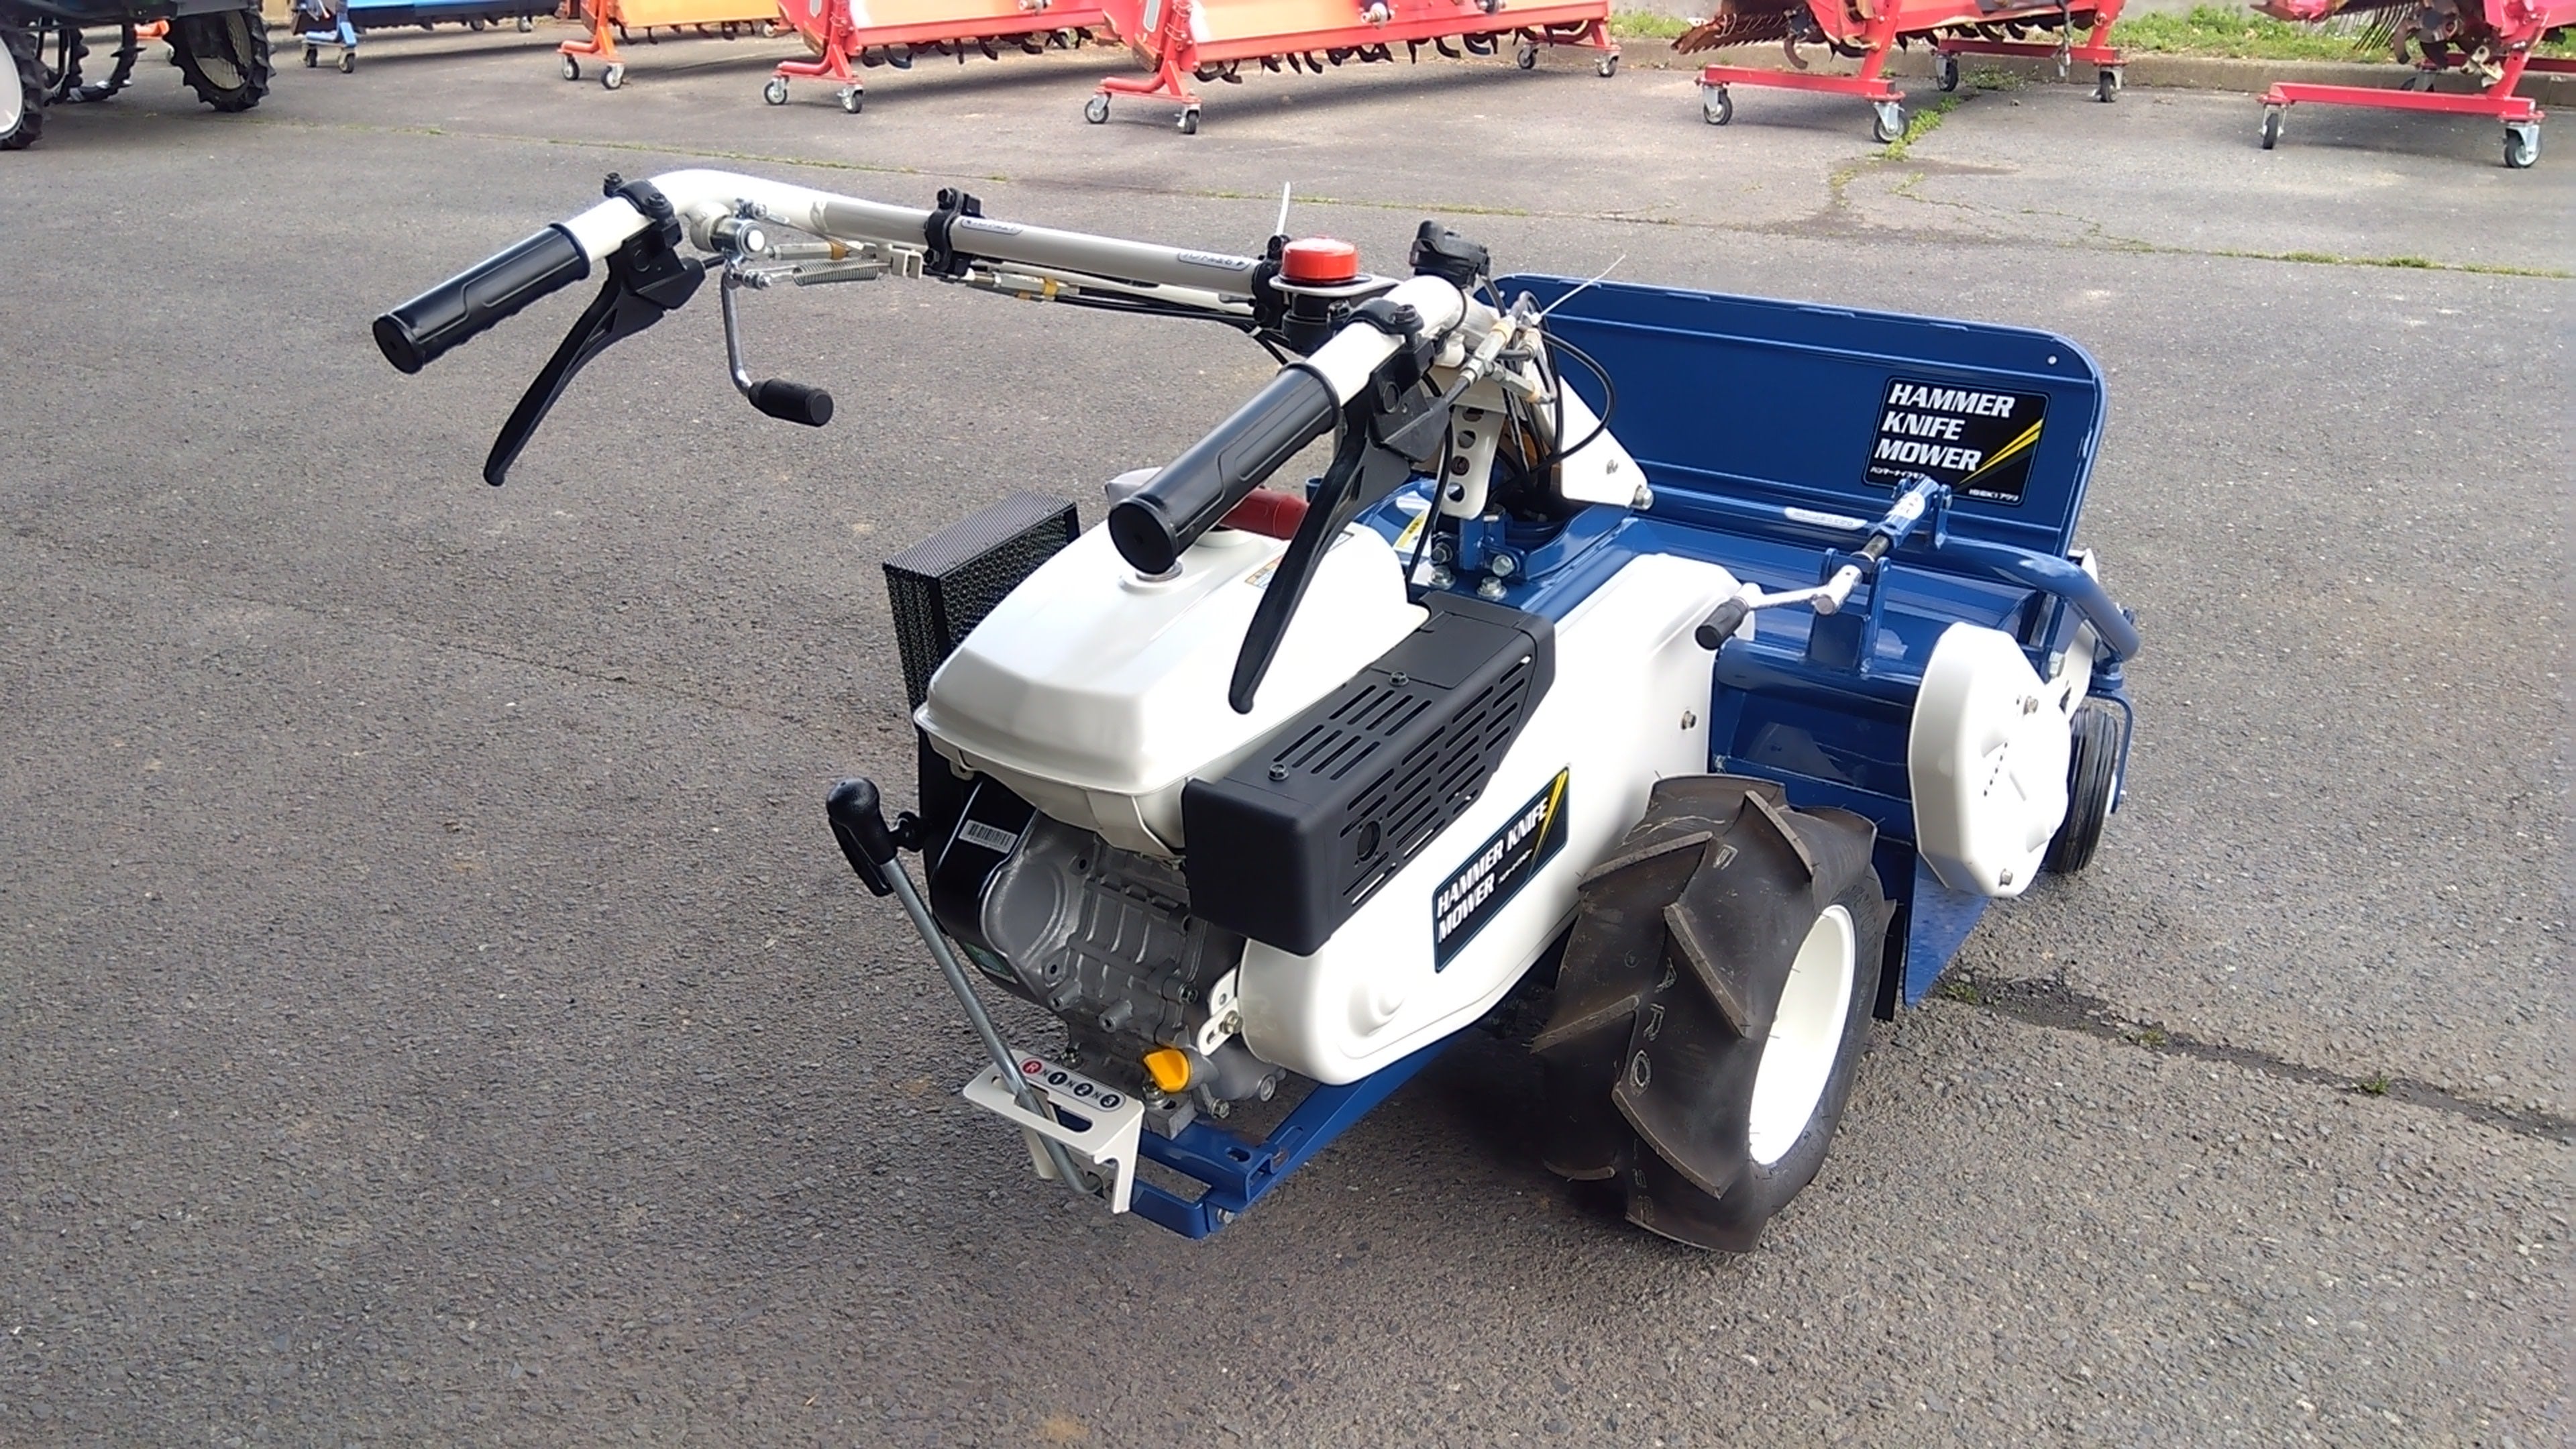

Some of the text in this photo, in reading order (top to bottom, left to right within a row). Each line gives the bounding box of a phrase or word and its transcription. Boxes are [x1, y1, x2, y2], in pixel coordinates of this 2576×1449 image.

[1888, 383, 2015, 419] HAMMER
[1881, 411, 1966, 441] KNIFE
[1874, 438, 1982, 472] MOWER
[1437, 839, 1504, 919] HAMMER
[1507, 796, 1549, 853] KNIFE
[1438, 872, 1495, 944] MOWER
